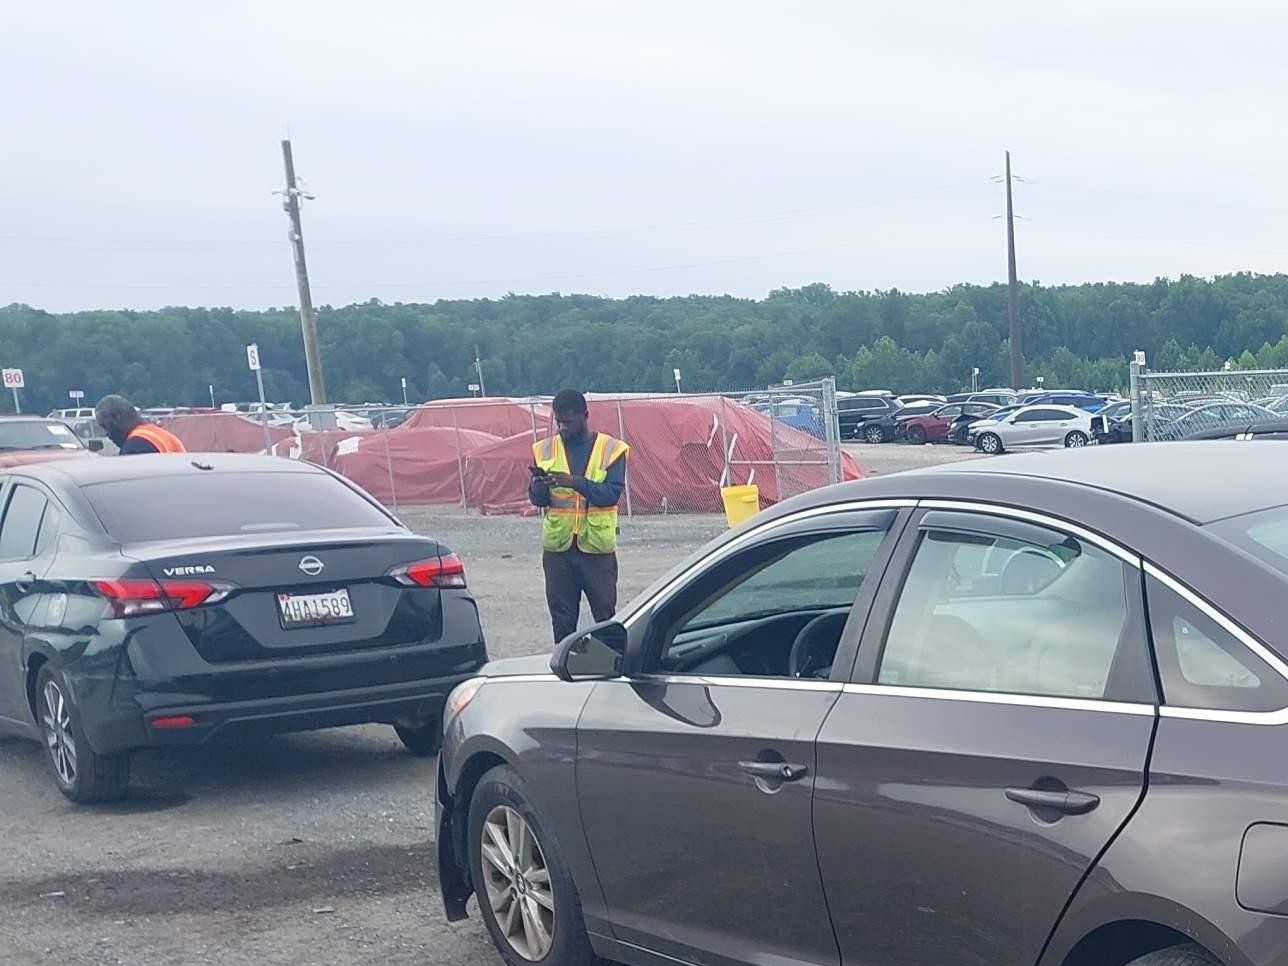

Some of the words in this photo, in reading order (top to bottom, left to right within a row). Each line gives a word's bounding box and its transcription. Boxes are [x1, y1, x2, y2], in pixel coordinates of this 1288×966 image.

[4, 373, 22, 384] 80
[163, 565, 215, 576] VERSA
[283, 596, 350, 620] 4HA1589
